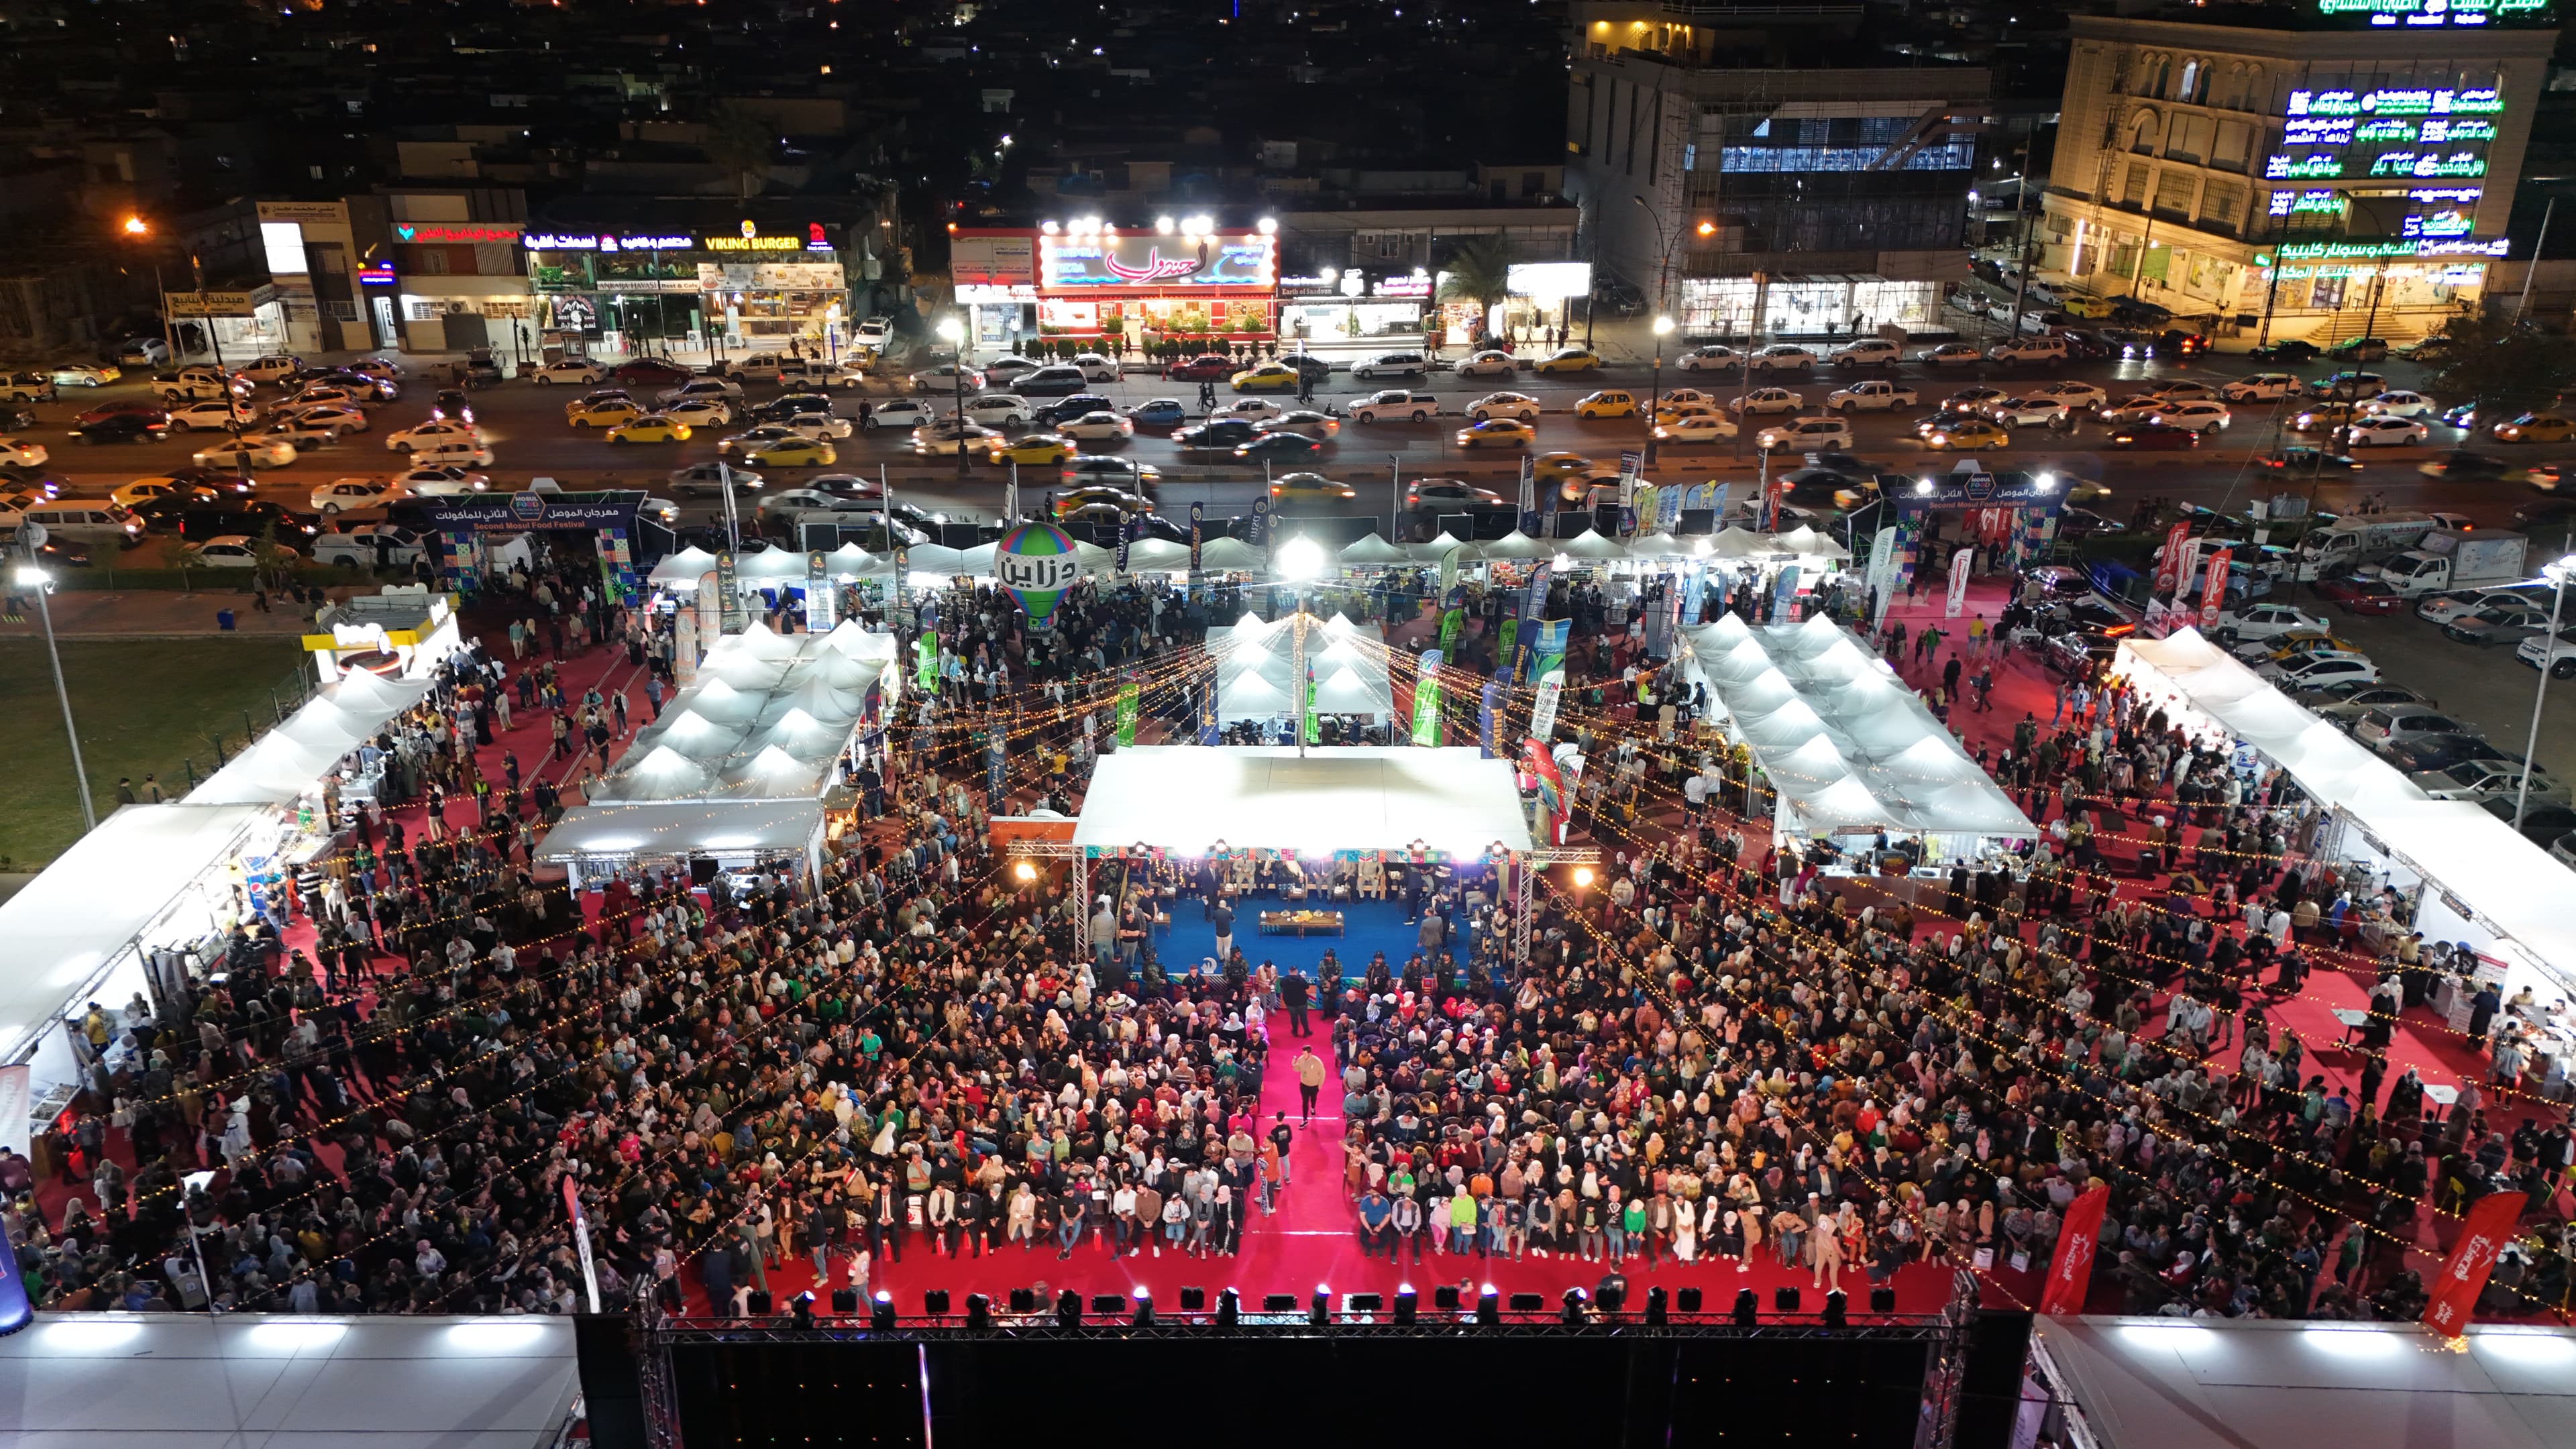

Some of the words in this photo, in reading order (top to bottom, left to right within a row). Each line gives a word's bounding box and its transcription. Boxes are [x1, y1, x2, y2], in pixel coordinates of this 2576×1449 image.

[415, 227, 443, 243] الطبي
[445, 227, 485, 241] الينابيع
[486, 229, 519, 241] مجمع
[705, 237, 749, 250] VIKING
[751, 236, 800, 250] BURGER
[208, 294, 245, 306] صيدلية
[1939, 490, 1962, 501] الثاني
[1996, 489, 2029, 498] الموصل
[482, 509, 508, 523] الثاني
[548, 508, 583, 519] الموصل
[584, 508, 619, 518] مهرجان
[474, 523, 506, 531] Second
[1001, 557, 1076, 588] دزاين
[1541, 681, 1560, 692] DZN
[1560, 763, 1579, 778] DZN
